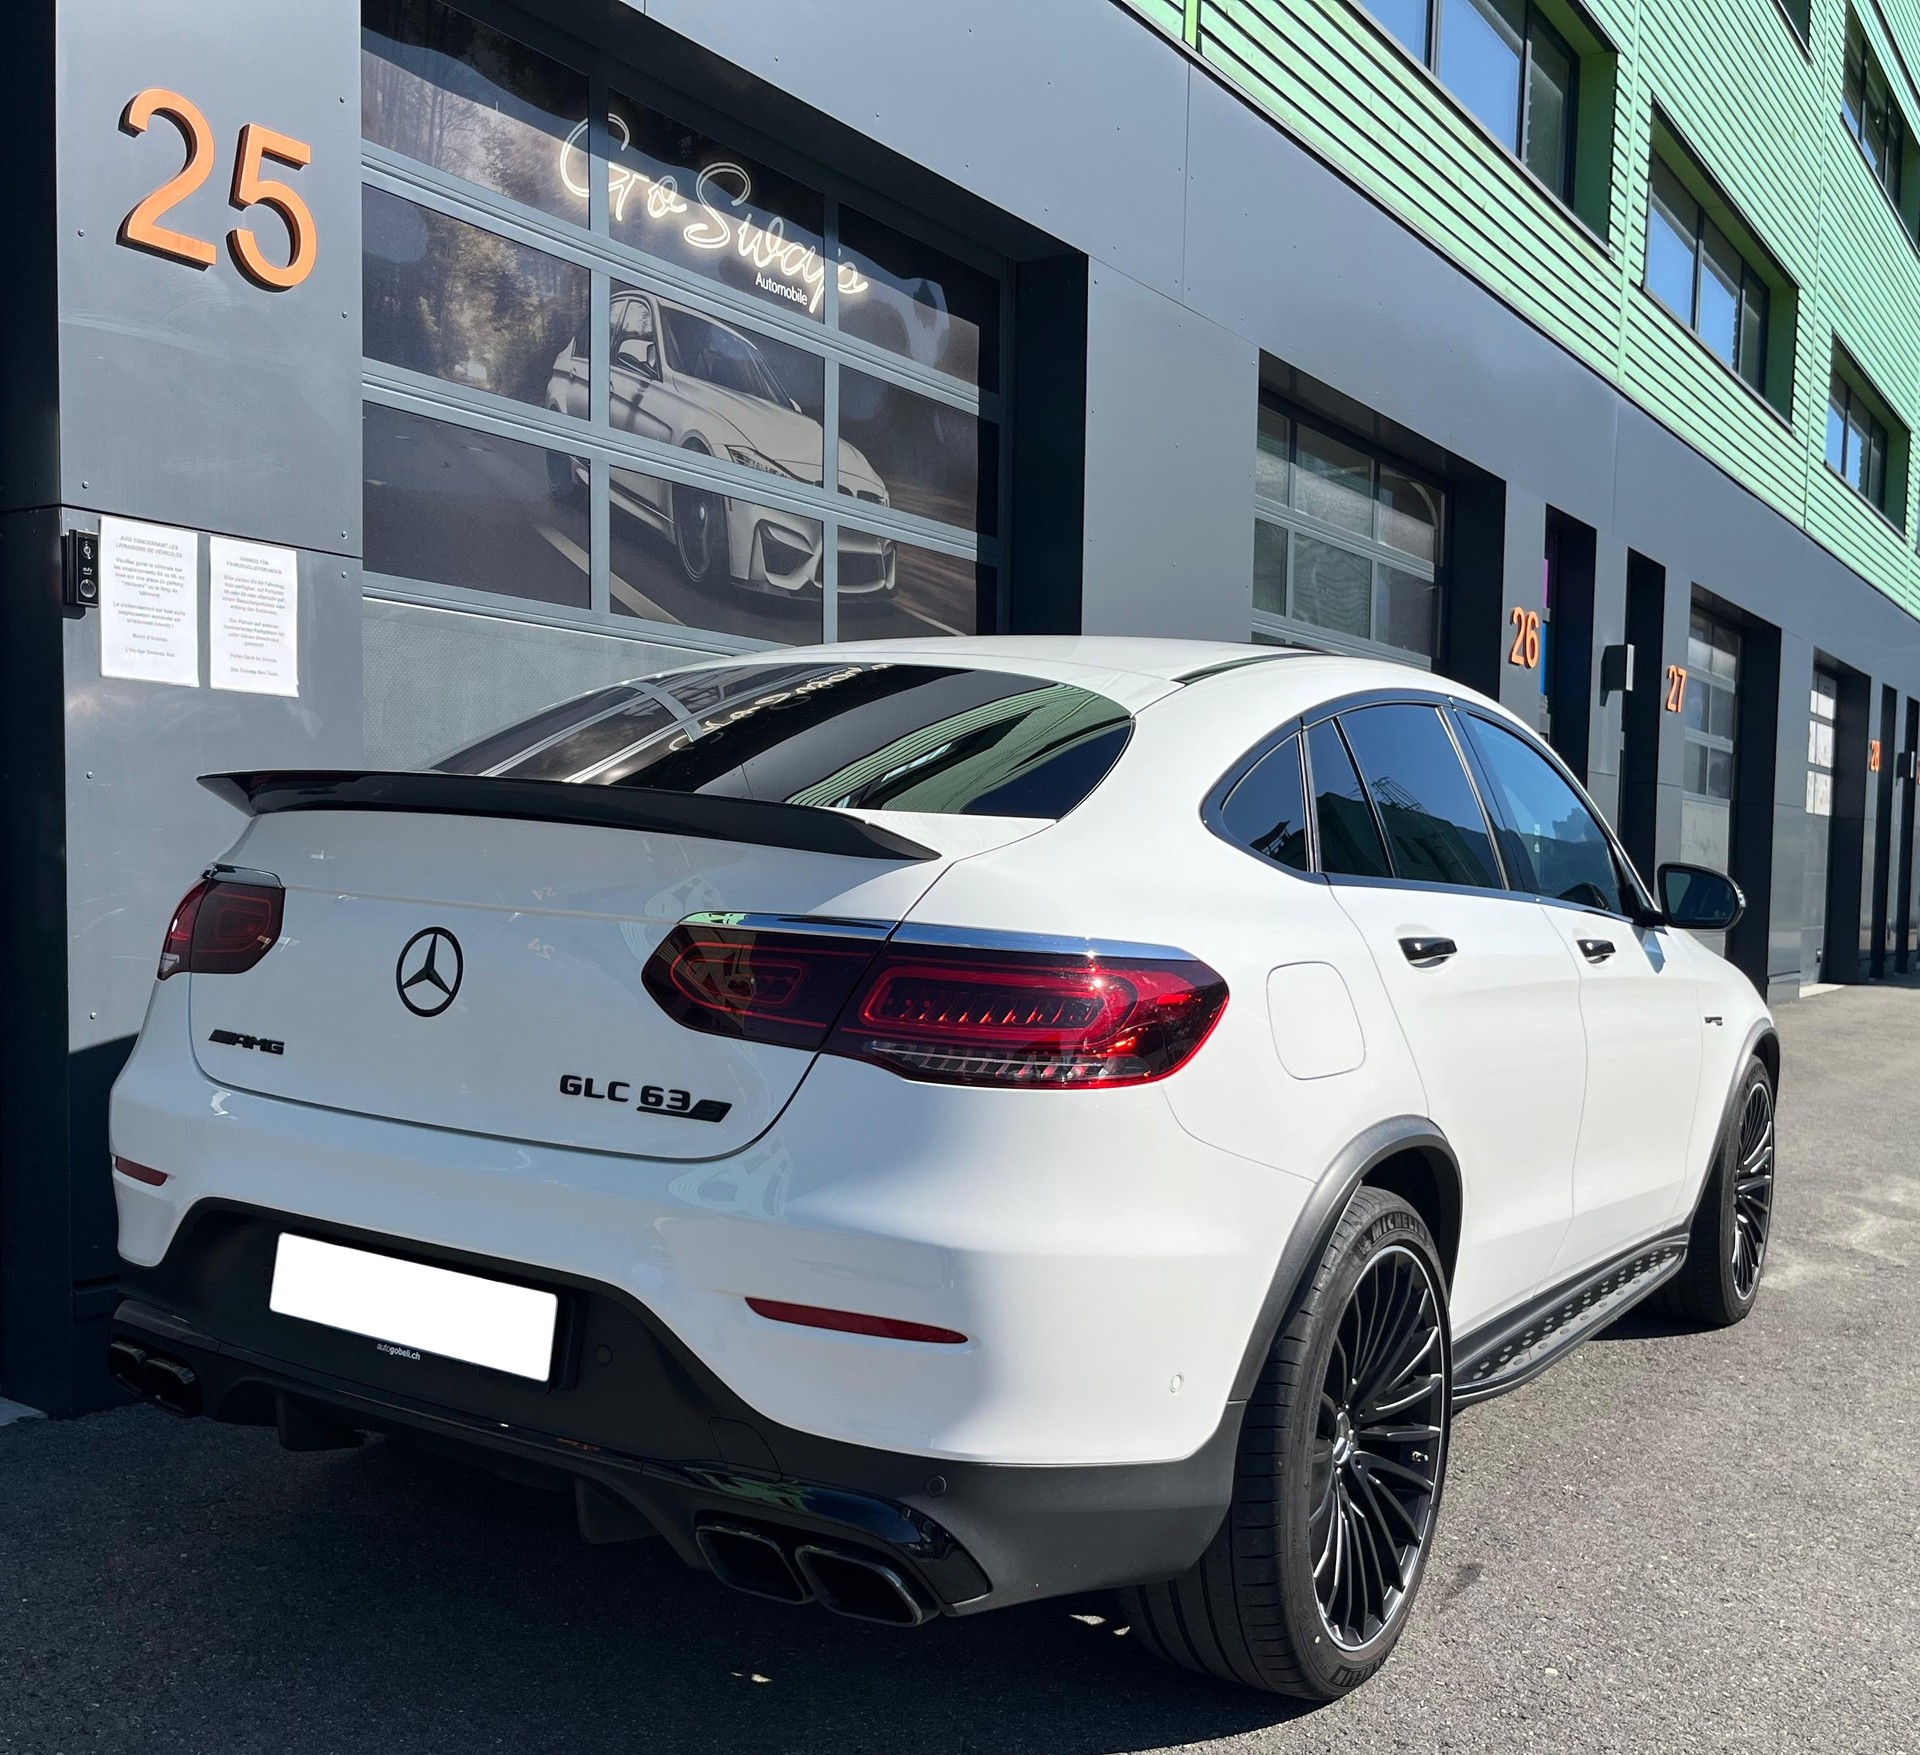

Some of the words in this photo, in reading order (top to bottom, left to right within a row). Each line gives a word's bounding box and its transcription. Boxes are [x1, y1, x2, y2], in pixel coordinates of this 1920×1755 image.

[116, 87, 318, 293] 25
[755, 272, 808, 306] Automobile
[1509, 606, 1539, 669] 26
[1665, 664, 1687, 713] 27
[228, 1033, 285, 1056] AMG
[559, 1074, 630, 1103] GLC
[640, 1085, 691, 1112] 63
[1371, 1212, 1427, 1241] MICHELIN
[376, 1343, 421, 1361] autogobeli.ch
